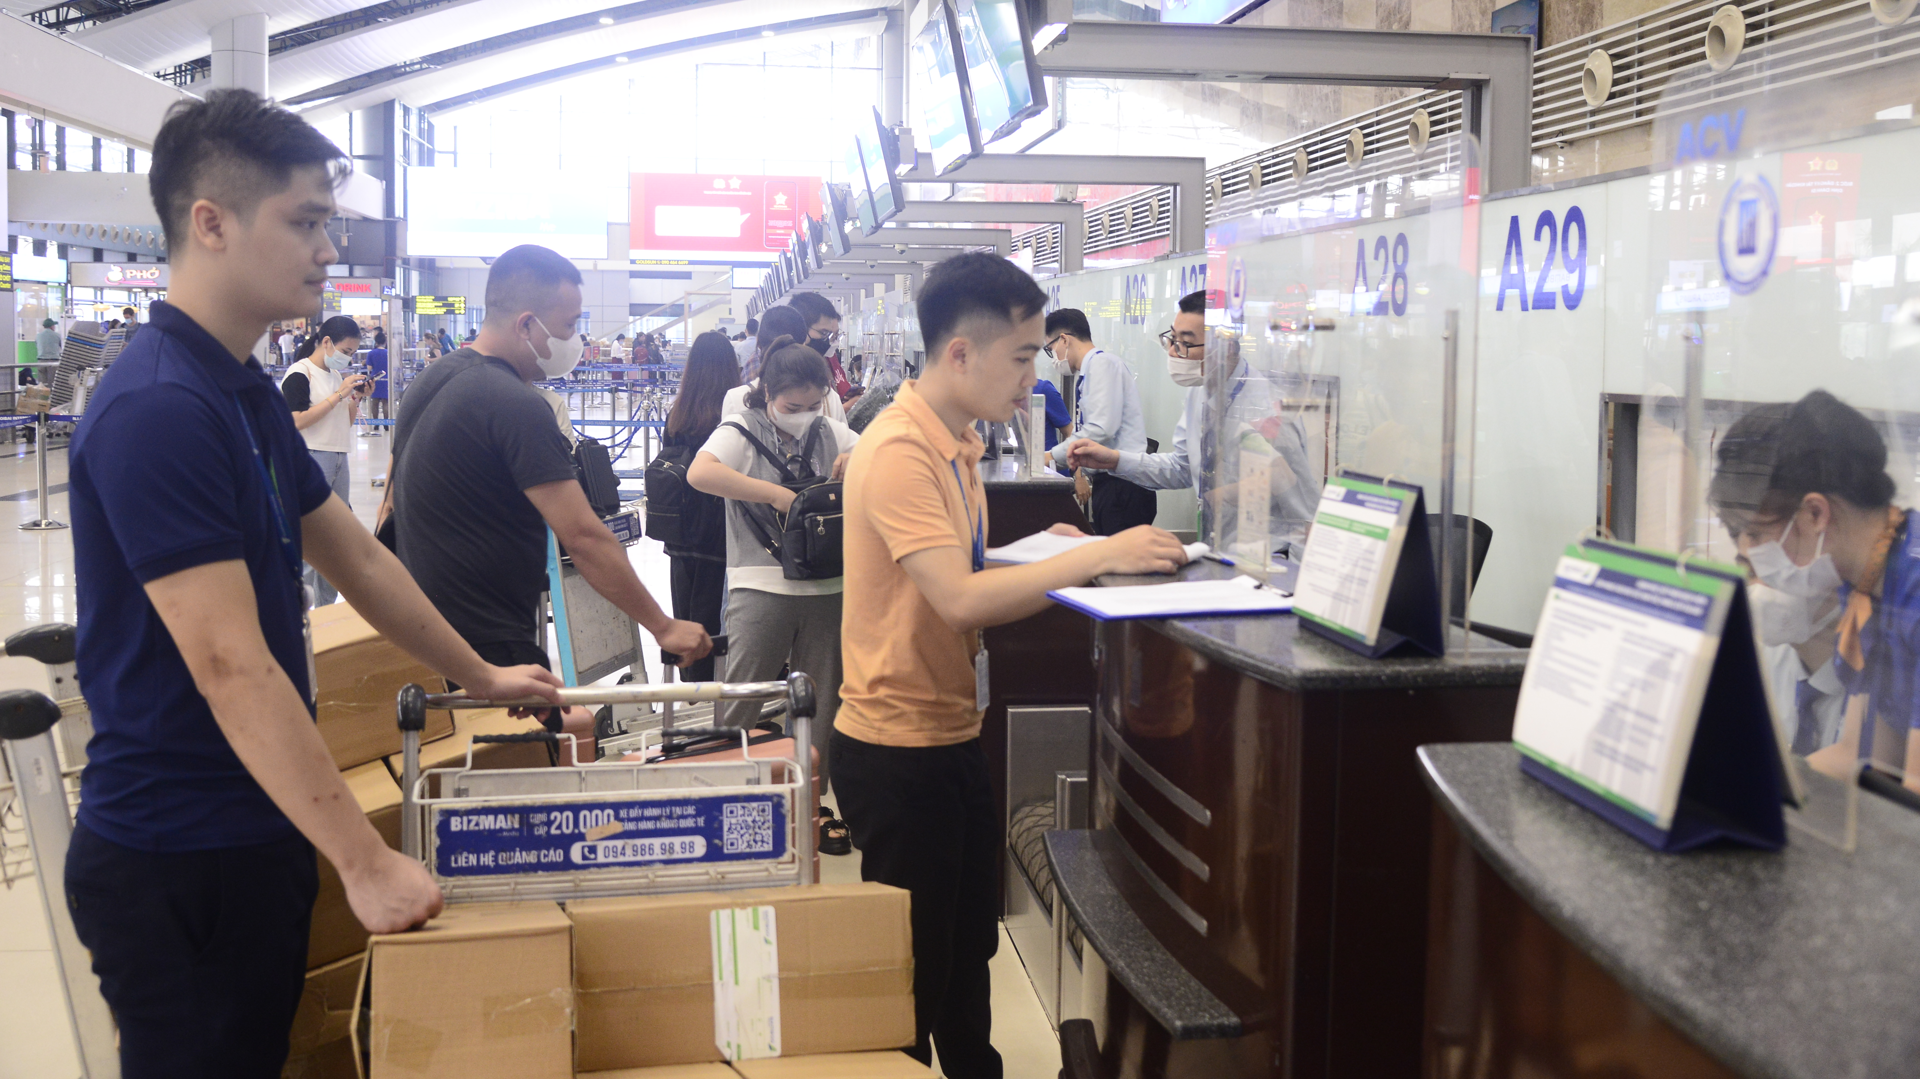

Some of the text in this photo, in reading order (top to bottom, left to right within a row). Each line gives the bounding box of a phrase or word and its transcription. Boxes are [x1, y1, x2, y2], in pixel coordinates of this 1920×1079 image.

[1675, 107, 1746, 164] ACV
[1495, 205, 1588, 313] A29
[125, 266, 160, 279] PHỞ
[1179, 263, 1207, 300] A27
[1349, 232, 1410, 318] A28
[335, 282, 372, 294] DRINK
[1123, 273, 1146, 326] A26
[450, 813, 520, 831] BIZMAN
[550, 809, 615, 835] 20.000
[619, 809, 629, 818] XE
[662, 805, 671, 816] LÝ
[683, 805, 697, 815] CÁC
[637, 818, 656, 830] HÀNG
[451, 847, 564, 868] LIÊN HỆ QUẢNG CÁO
[603, 841, 695, 860] 094.986.98.98
